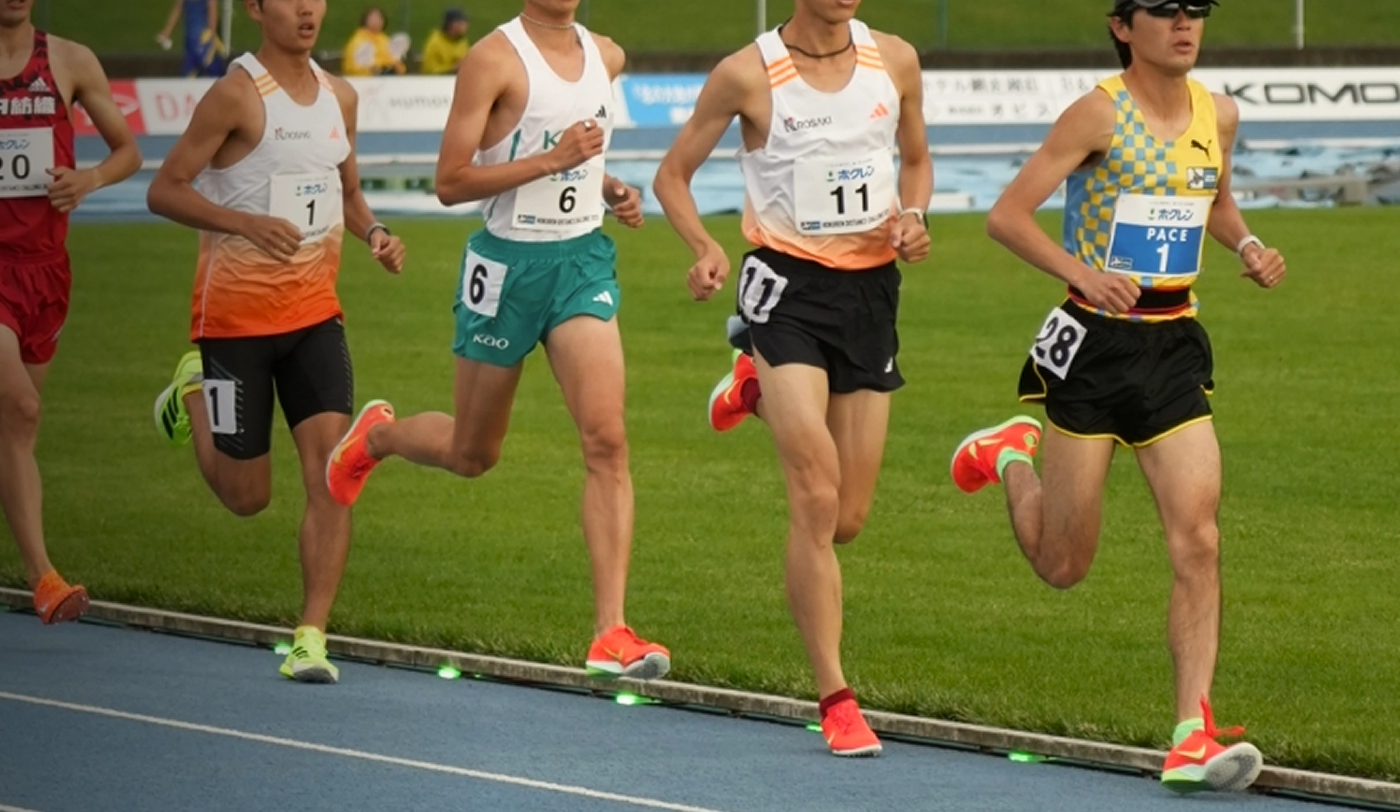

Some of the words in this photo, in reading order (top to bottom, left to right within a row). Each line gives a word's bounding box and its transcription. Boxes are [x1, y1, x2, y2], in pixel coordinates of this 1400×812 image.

[838, 165, 875, 181] ホクレン
[306, 199, 315, 226] 1
[559, 186, 577, 213] 6
[830, 183, 869, 214] 11
[1158, 207, 1194, 221] ホクレン
[1146, 227, 1188, 242] PACE
[1156, 243, 1169, 273] 1
[469, 263, 488, 305] 6
[741, 266, 777, 316] 11
[1035, 316, 1078, 368] 28
[209, 386, 220, 426] 1
